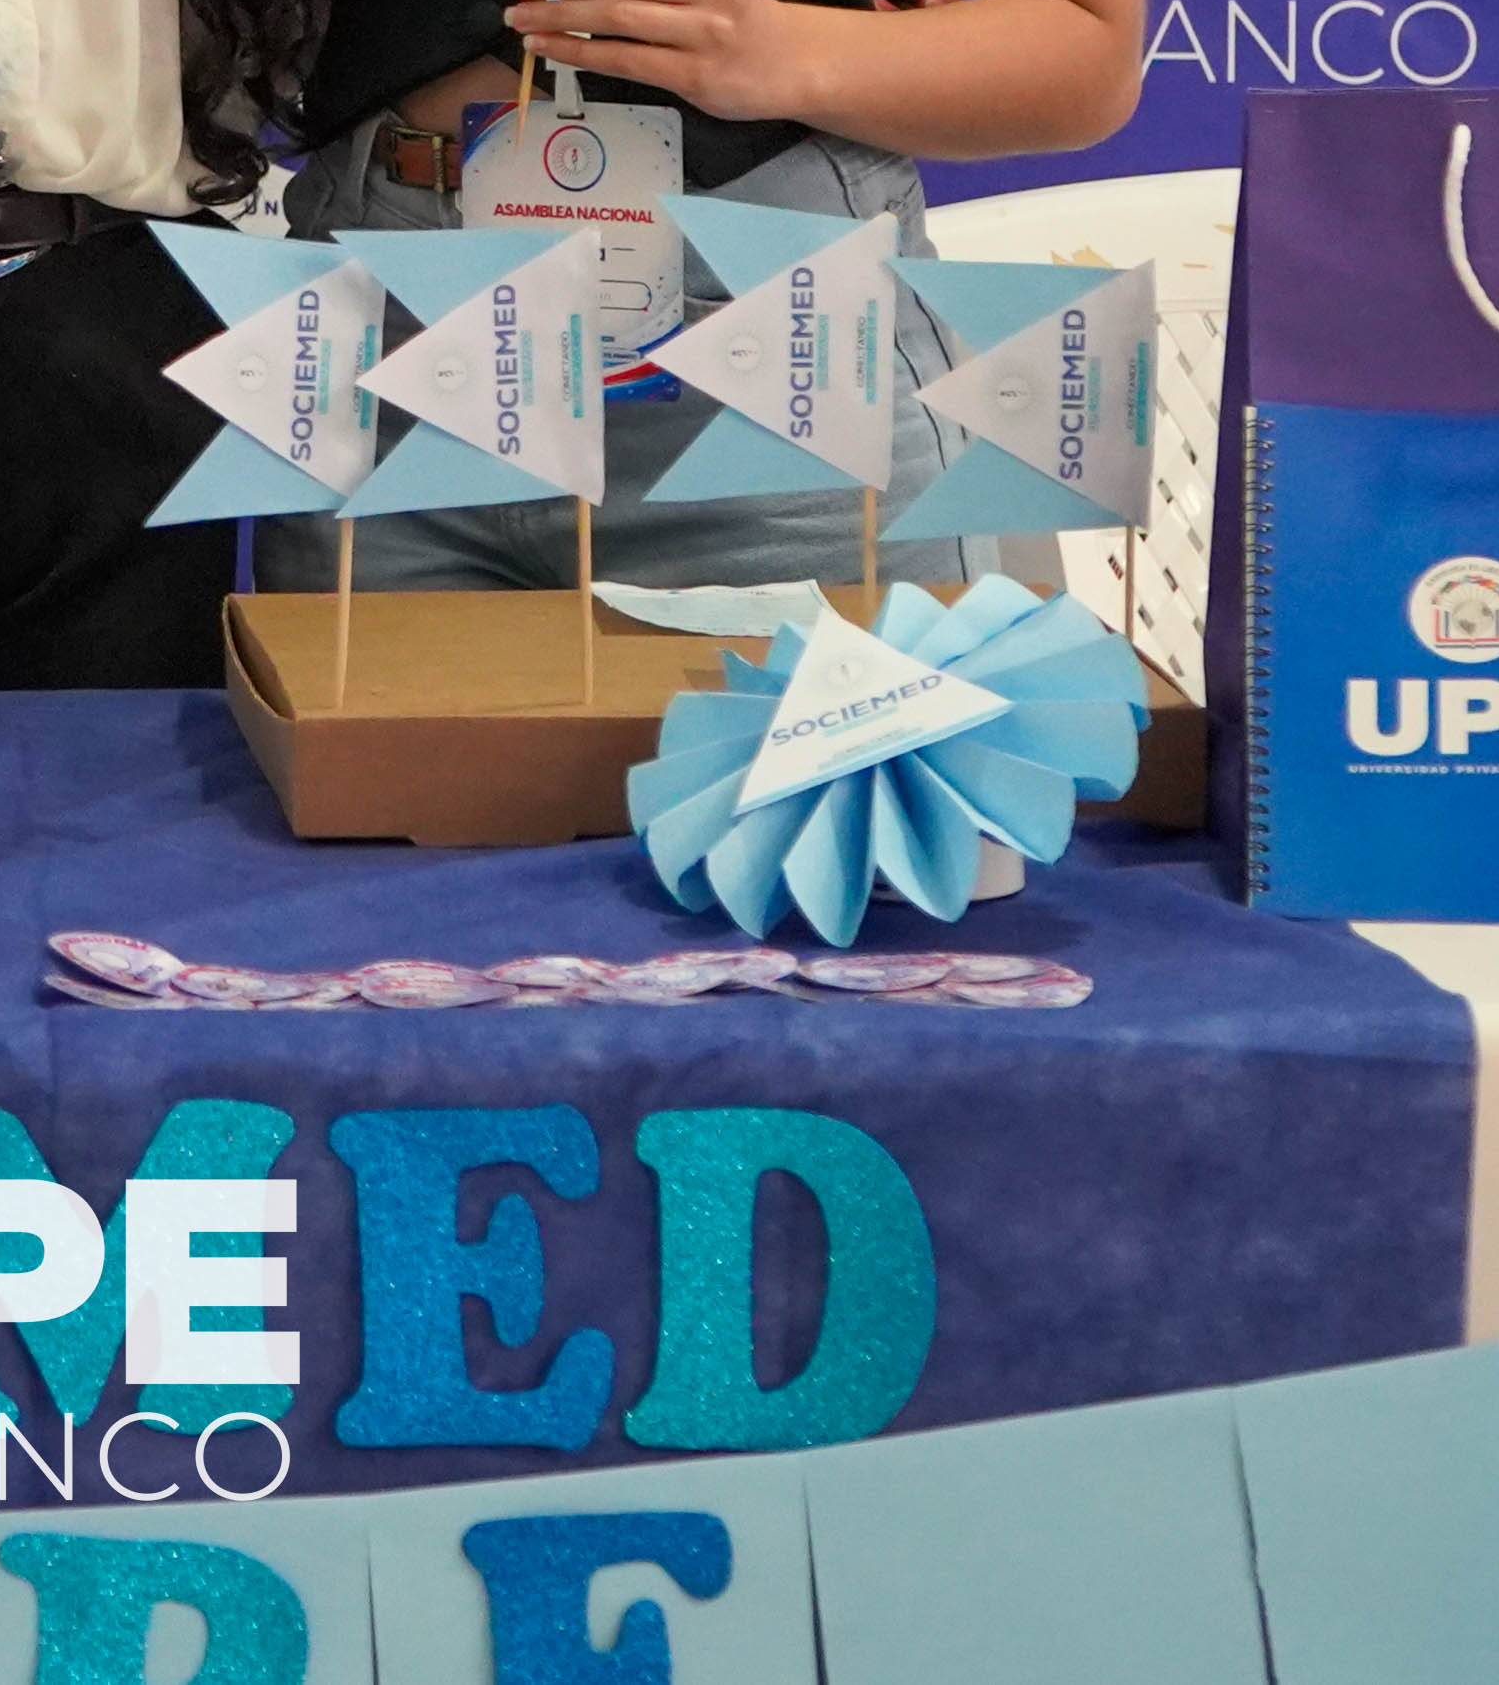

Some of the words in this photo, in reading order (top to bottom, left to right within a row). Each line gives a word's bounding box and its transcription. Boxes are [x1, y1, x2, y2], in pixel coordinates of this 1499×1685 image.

[493, 203, 575, 219] ASAMBLEA
[576, 207, 655, 224] NACIONAL
[290, 289, 320, 462] SOCIEMED
[493, 284, 521, 456] SOCIEMED
[789, 267, 815, 439] SOCIEMED
[1059, 309, 1086, 481] SOCIEMED
[770, 674, 943, 746] SOCIEMED
